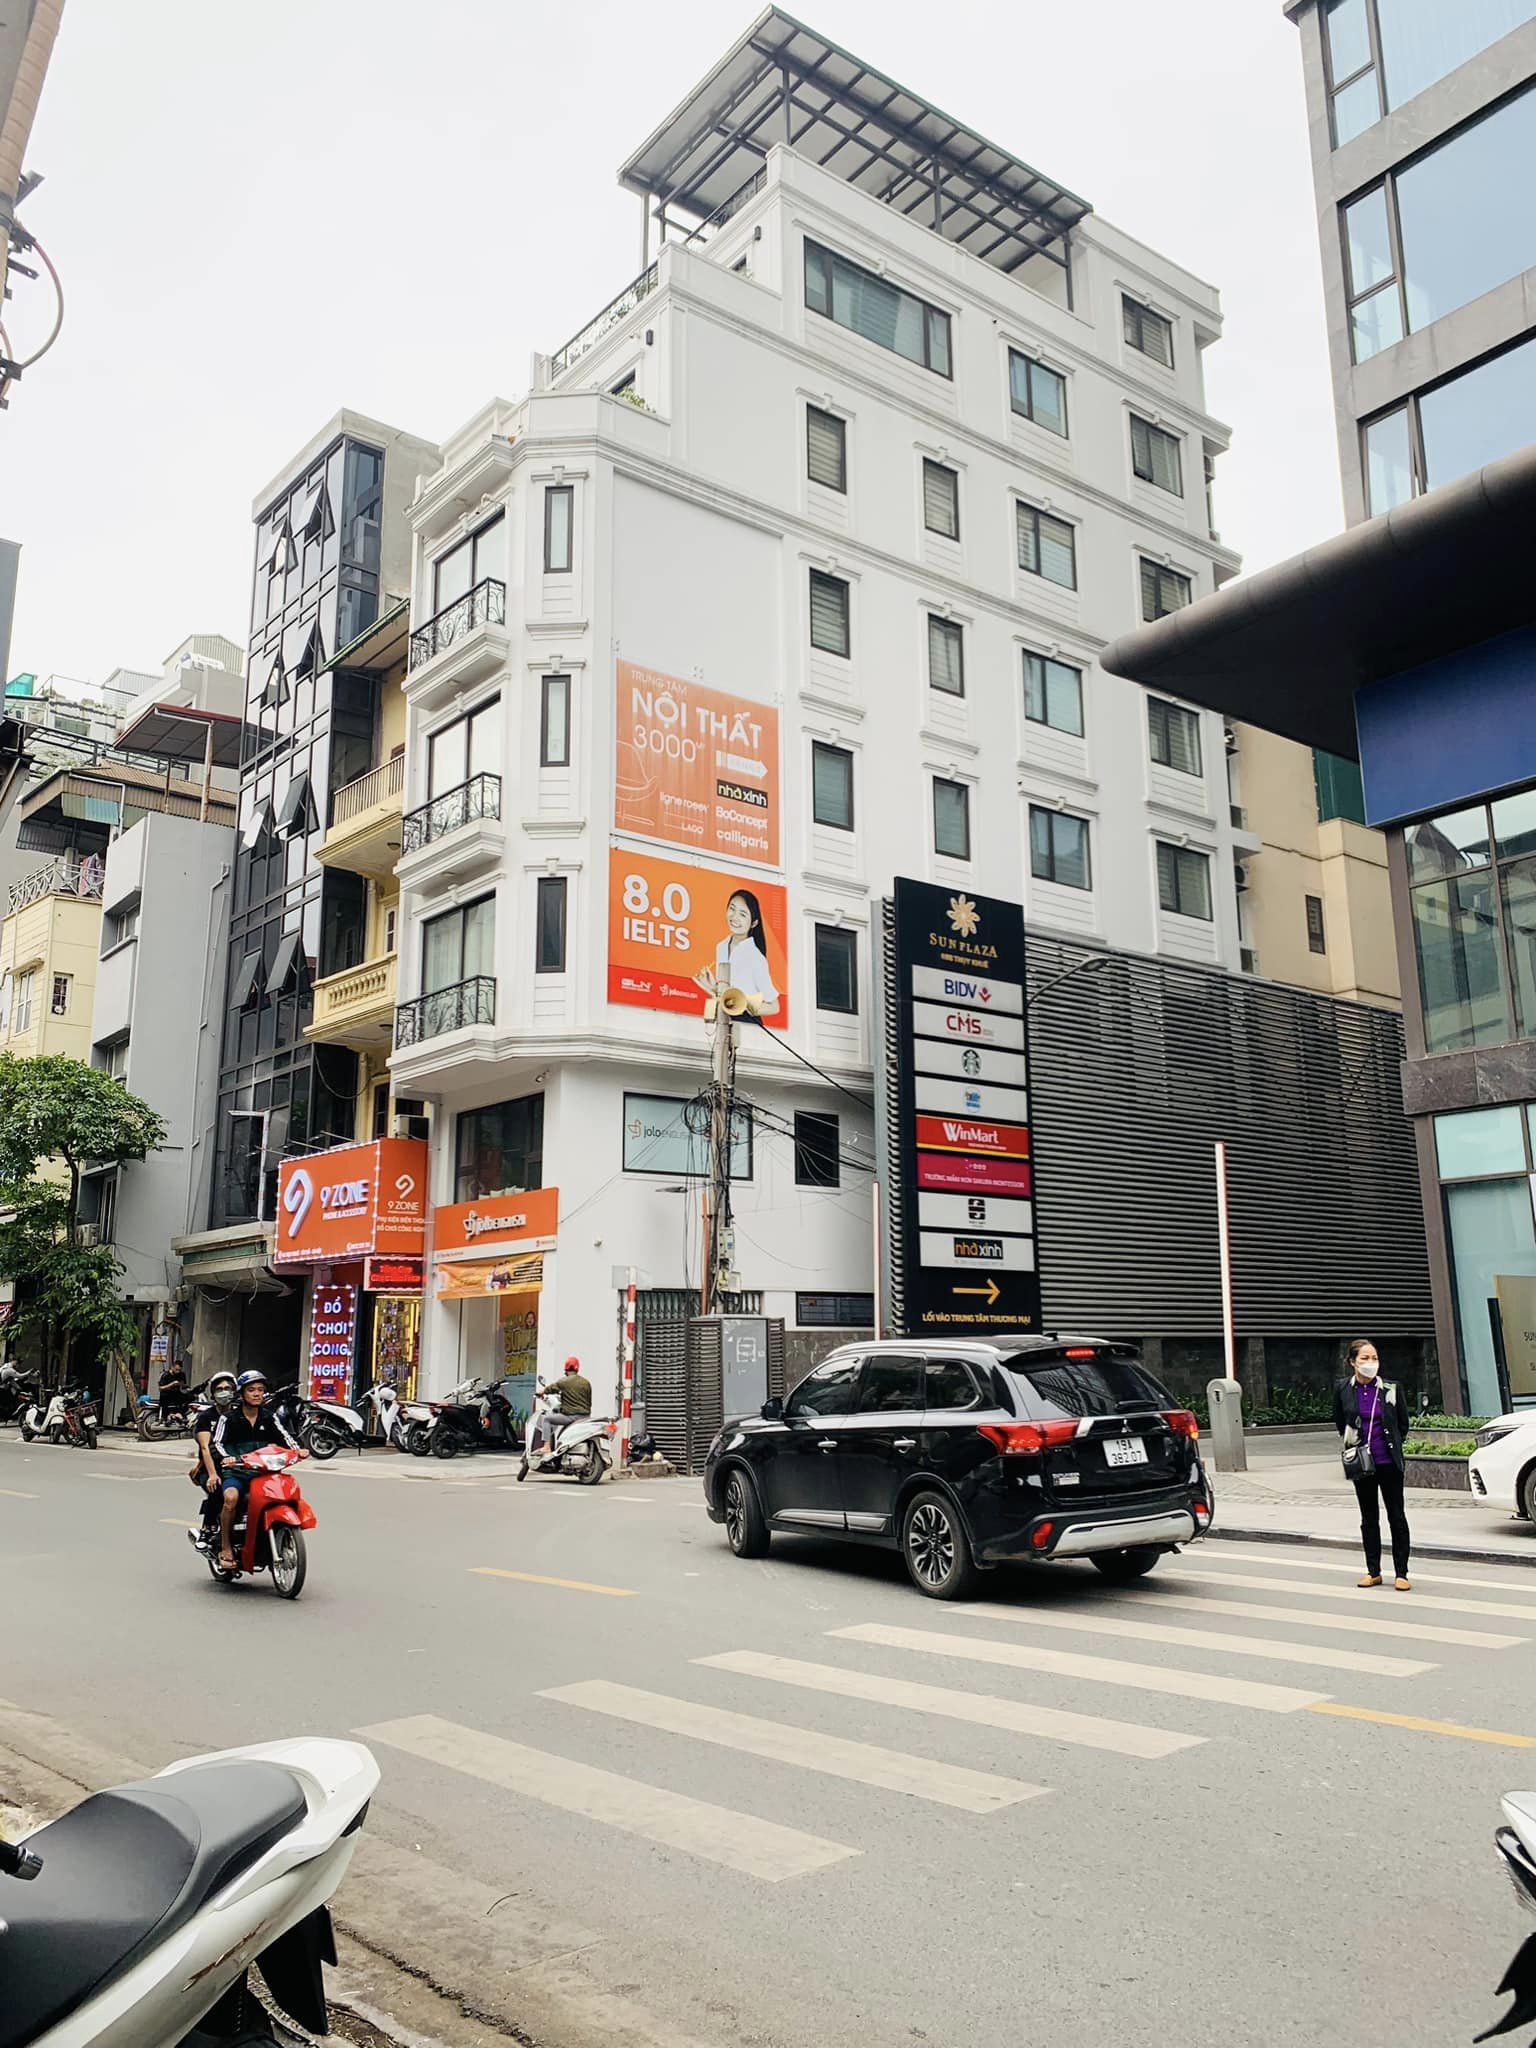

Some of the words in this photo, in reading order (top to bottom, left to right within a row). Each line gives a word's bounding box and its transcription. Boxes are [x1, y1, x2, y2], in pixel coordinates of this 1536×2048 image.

[631, 687, 687, 729] NỘI
[696, 706, 762, 749] THẤT
[716, 829, 769, 850] calligaris
[622, 874, 691, 922] 8.0
[622, 916, 691, 950] IELTS
[929, 932, 957, 949] SUN
[958, 940, 998, 958] PLAZA
[944, 979, 977, 999] BIDV
[946, 1012, 982, 1034] CMS
[942, 1121, 1000, 1144] WinMart
[320, 1186, 331, 1209] 9
[331, 1179, 369, 1207] ZONE
[387, 1200, 394, 1210] 9
[395, 1201, 420, 1211] ZONE
[316, 1321, 348, 1335] CHƠI
[313, 1362, 346, 1379] NGHỆ
[1116, 1439, 1133, 1450] 19A
